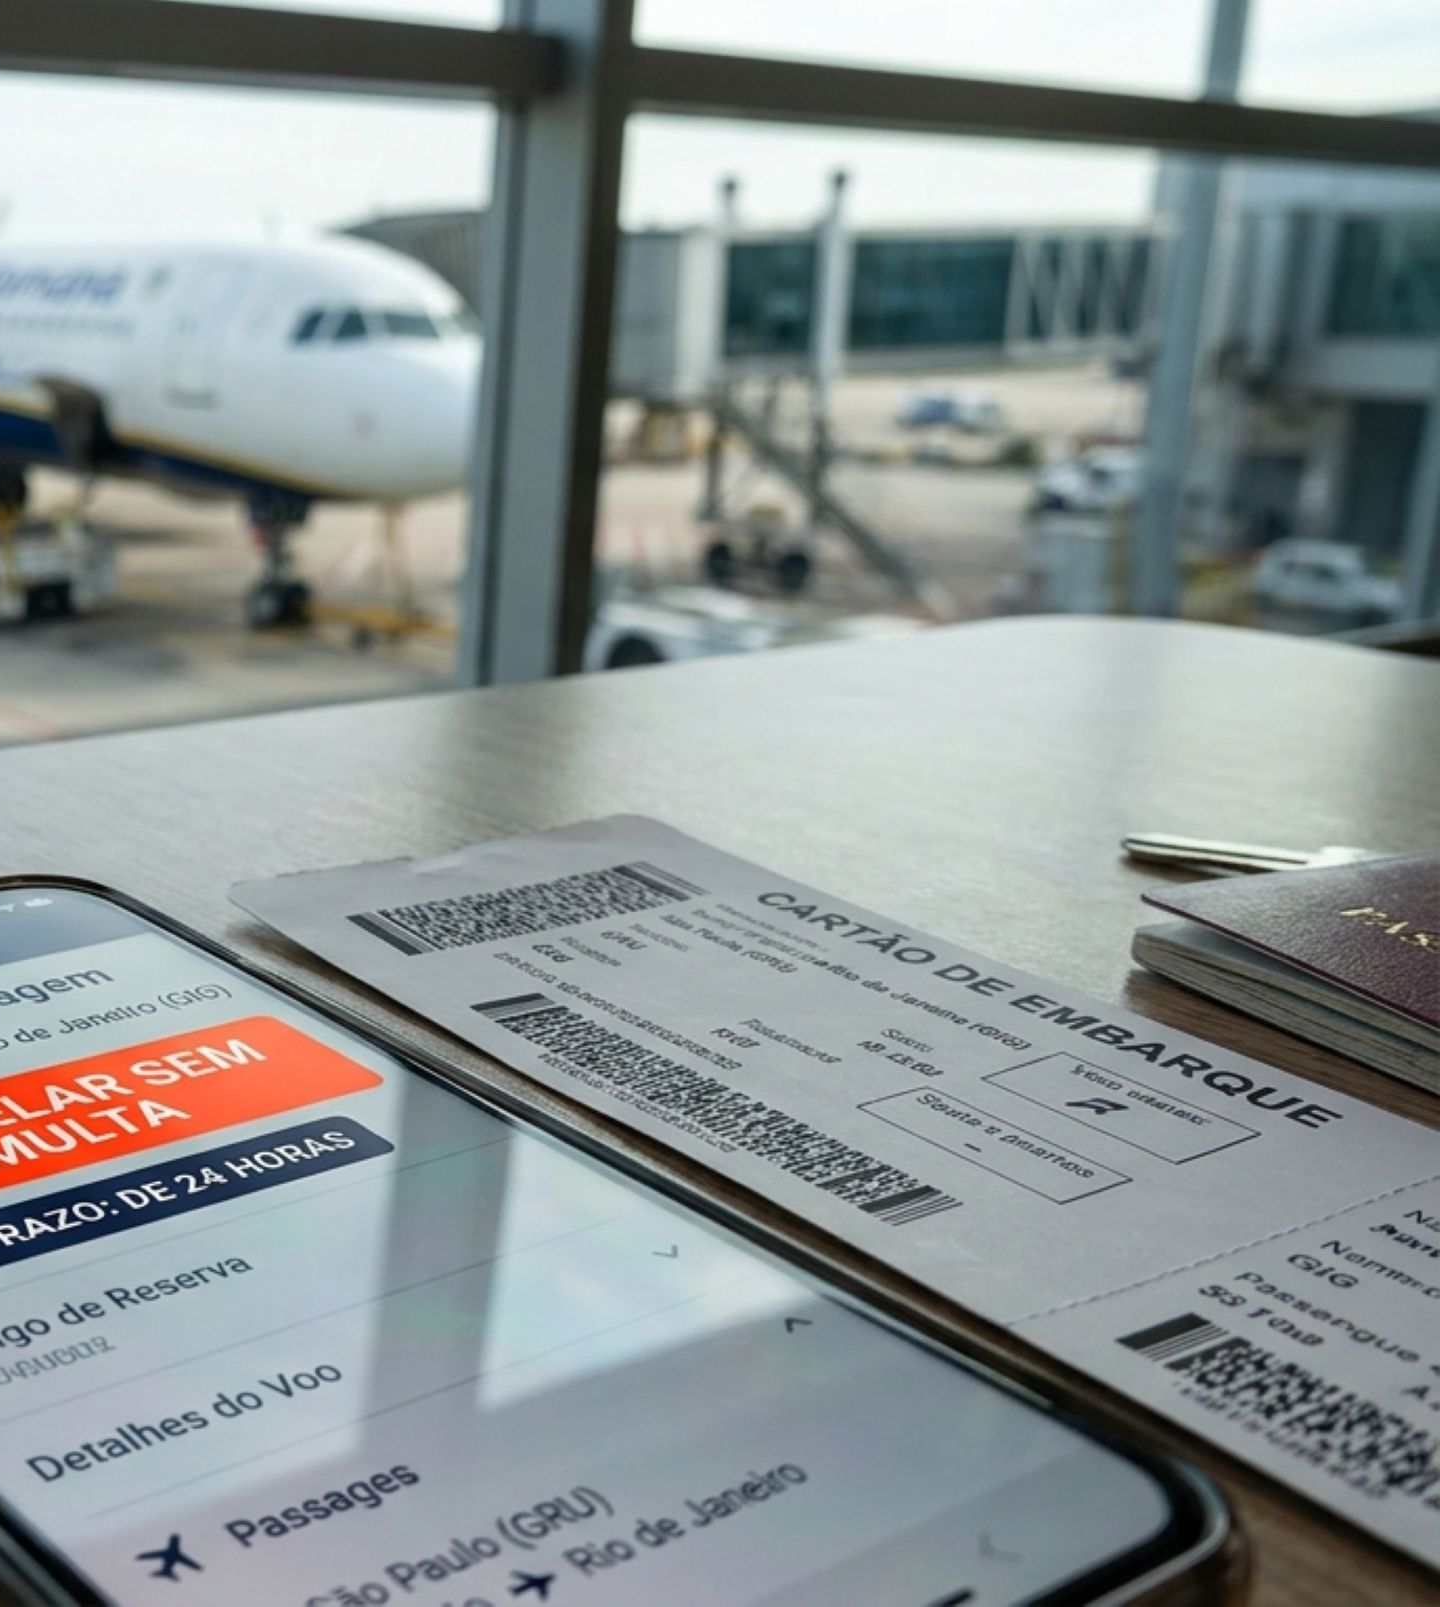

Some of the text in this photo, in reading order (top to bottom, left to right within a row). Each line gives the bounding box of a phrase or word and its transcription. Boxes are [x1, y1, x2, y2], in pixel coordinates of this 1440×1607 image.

[13, 1027, 52, 1044] de
[157, 983, 233, 1011] (GIG)
[757, 891, 937, 965] CARTÃO
[932, 962, 1016, 998] DE
[1008, 993, 1344, 1130] EMBARQUE
[129, 1037, 269, 1088] SEM
[115, 1180, 178, 1209] DE
[224, 1131, 358, 1181] HORAS
[56, 1300, 107, 1327] de
[104, 1253, 254, 1311] Reserva
[25, 1362, 343, 1484] Detalhes do Voo
[224, 1463, 421, 1549] Passages
[383, 1537, 502, 1594] Paulo
[495, 1485, 616, 1551] (GRU)
[562, 1457, 809, 1579] Rio de Janeiro
